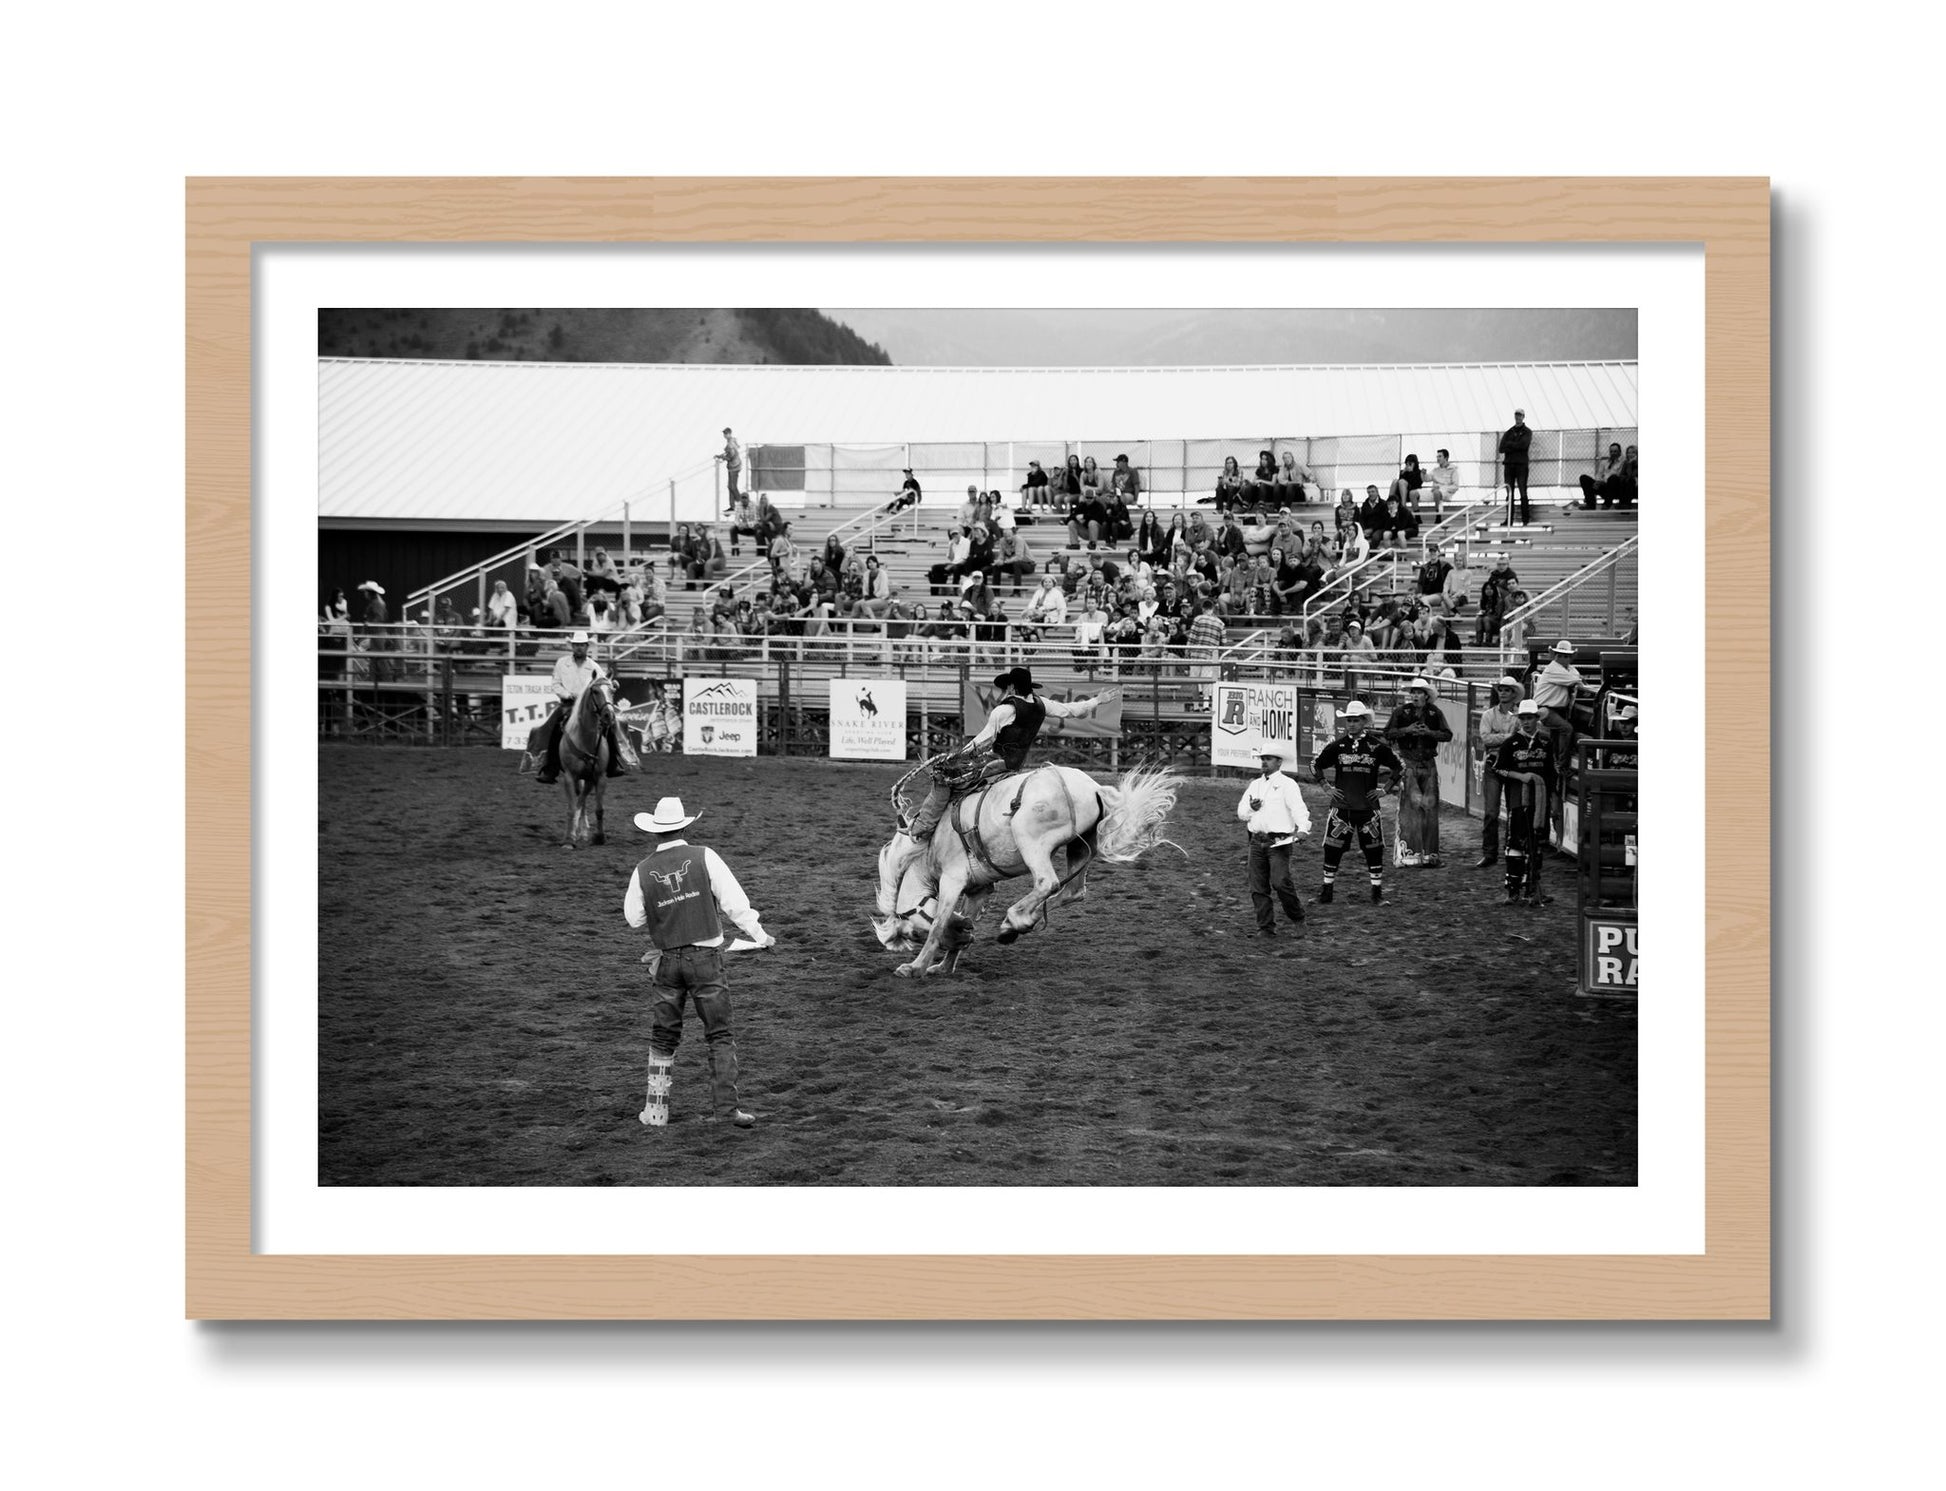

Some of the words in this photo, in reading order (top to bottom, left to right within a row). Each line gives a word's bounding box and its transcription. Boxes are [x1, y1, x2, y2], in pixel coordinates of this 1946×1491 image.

[1248, 688, 1292, 709] RANCH
[689, 702, 753, 716] CASTLEROCK
[1222, 700, 1245, 726] R
[831, 720, 865, 729] SNAKE
[871, 720, 905, 729] RIVER
[1262, 709, 1293, 740] HOME
[719, 730, 741, 742] Jeep
